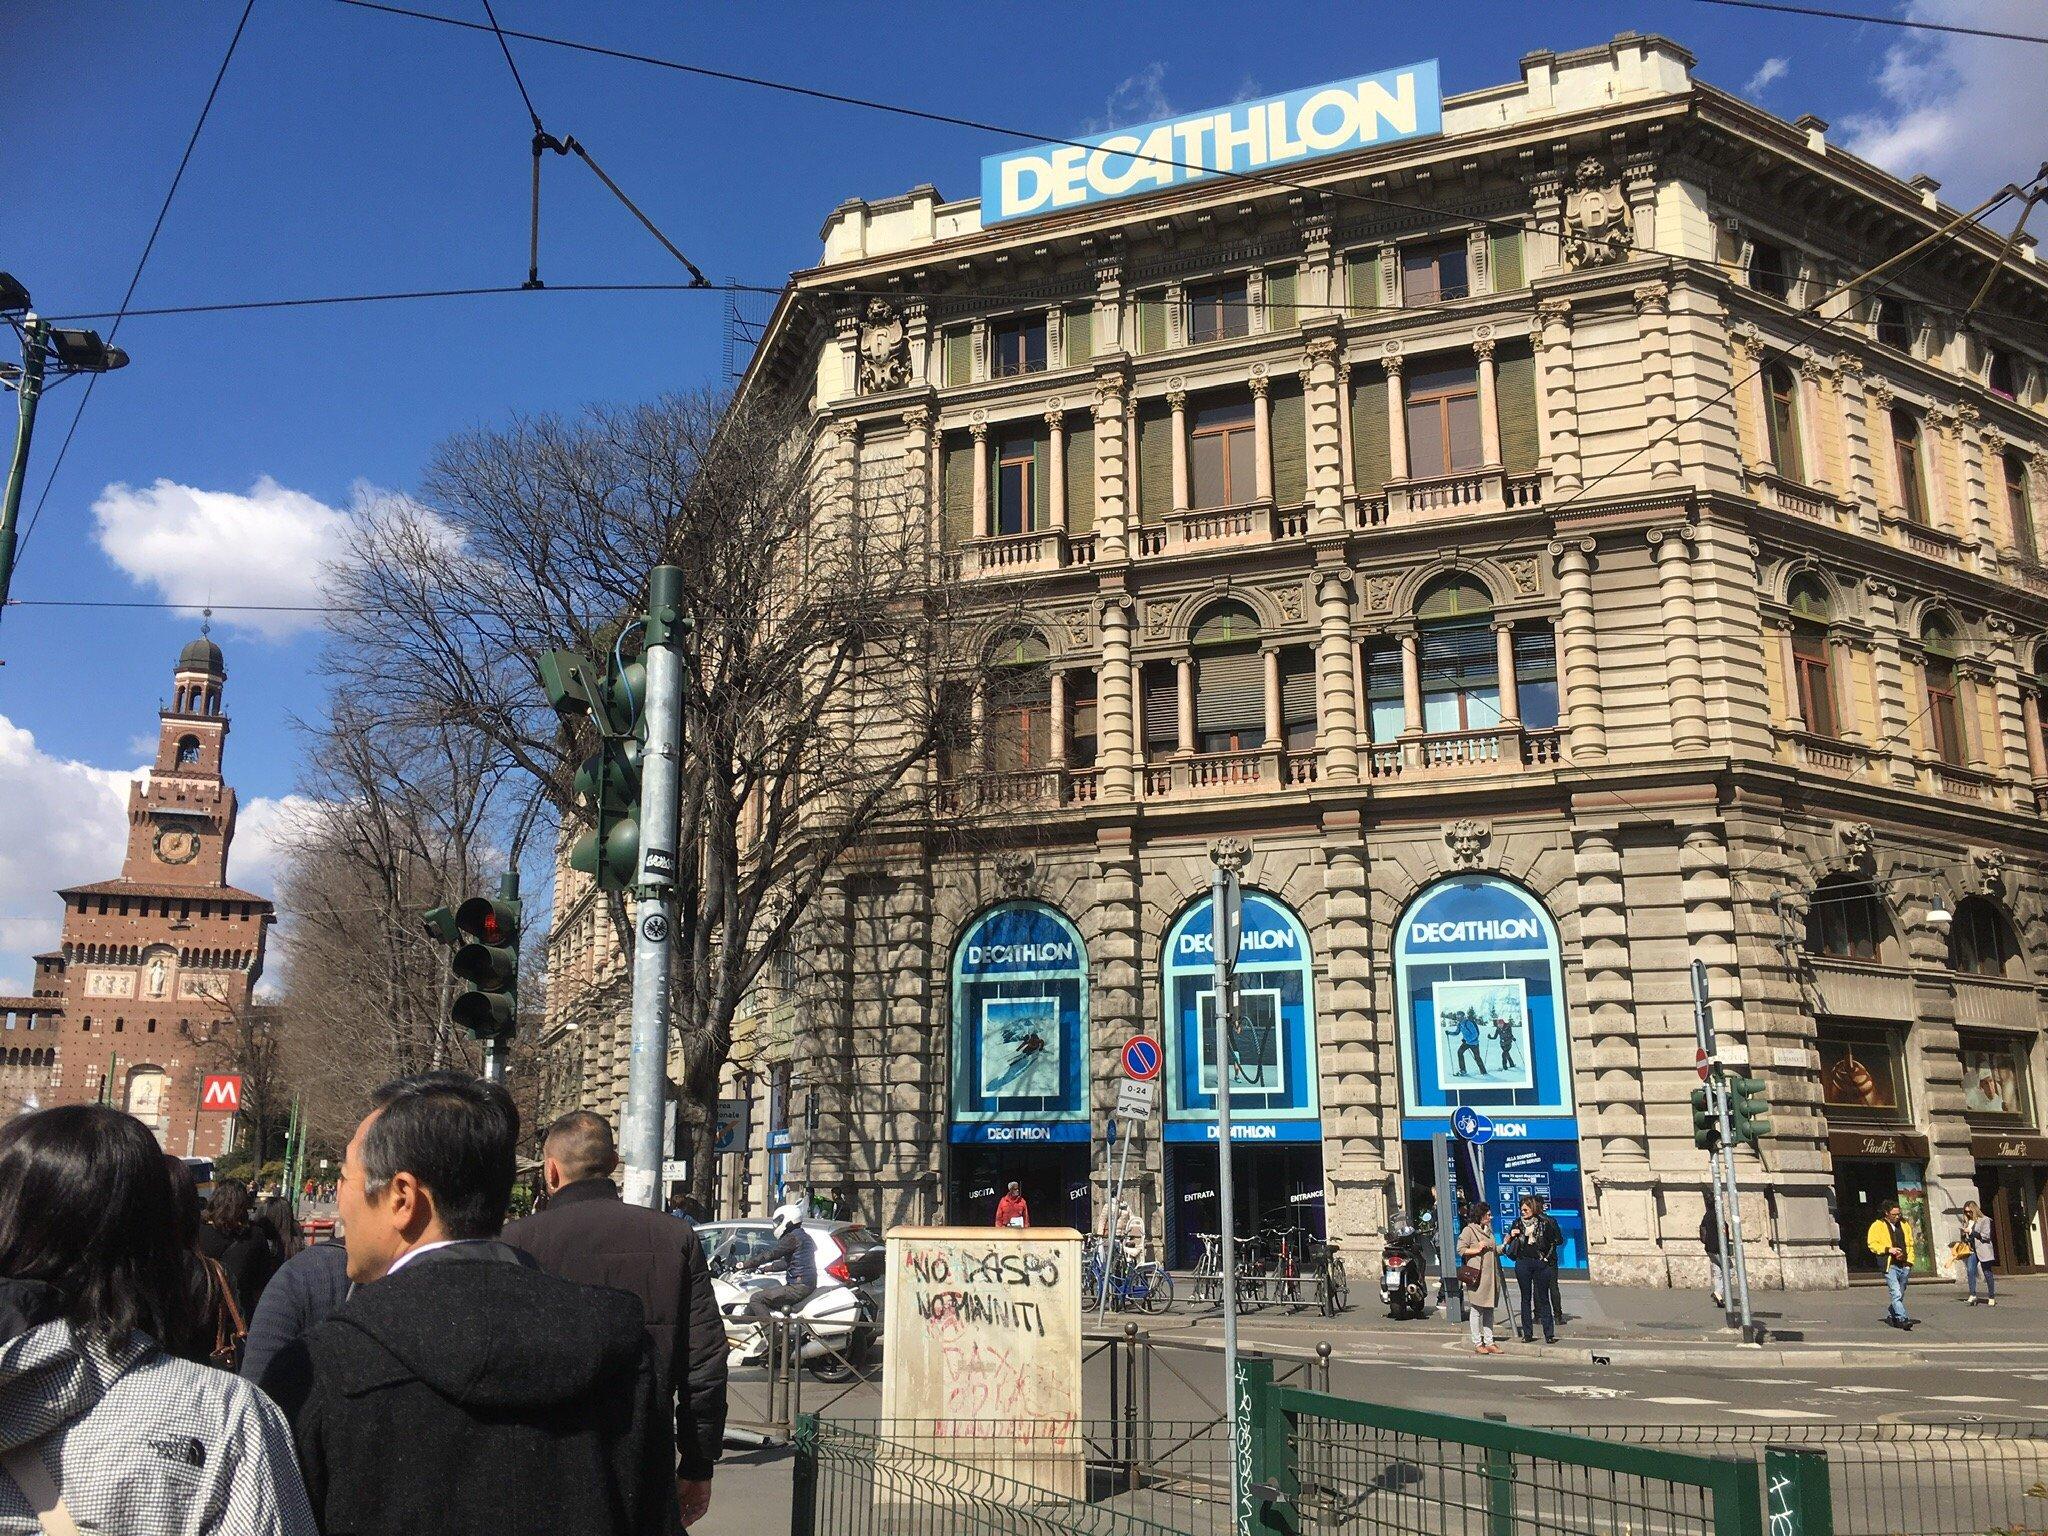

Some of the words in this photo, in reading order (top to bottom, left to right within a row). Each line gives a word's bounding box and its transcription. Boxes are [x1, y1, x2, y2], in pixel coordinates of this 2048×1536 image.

[1001, 73, 1418, 217] DECATHLON
[1411, 919, 1538, 944] DECATHLON
[1180, 928, 1294, 954] DEHLON
[968, 942, 1073, 965] DECATHLON
[203, 1080, 237, 1104] M
[1127, 1085, 1147, 1095] 0-24
[987, 1127, 1051, 1140] DECATHLON
[1207, 1125, 1277, 1139] DATHLON
[1862, 1138, 1888, 1154] Lindt
[1997, 1141, 2020, 1156] Lindt
[969, 1187, 995, 1199] USCITA
[1070, 1186, 1088, 1200] EXIT
[1184, 1190, 1215, 1202] ENTRATA
[1290, 1190, 1324, 1203] ENTRANCE
[913, 1254, 949, 1284] NO
